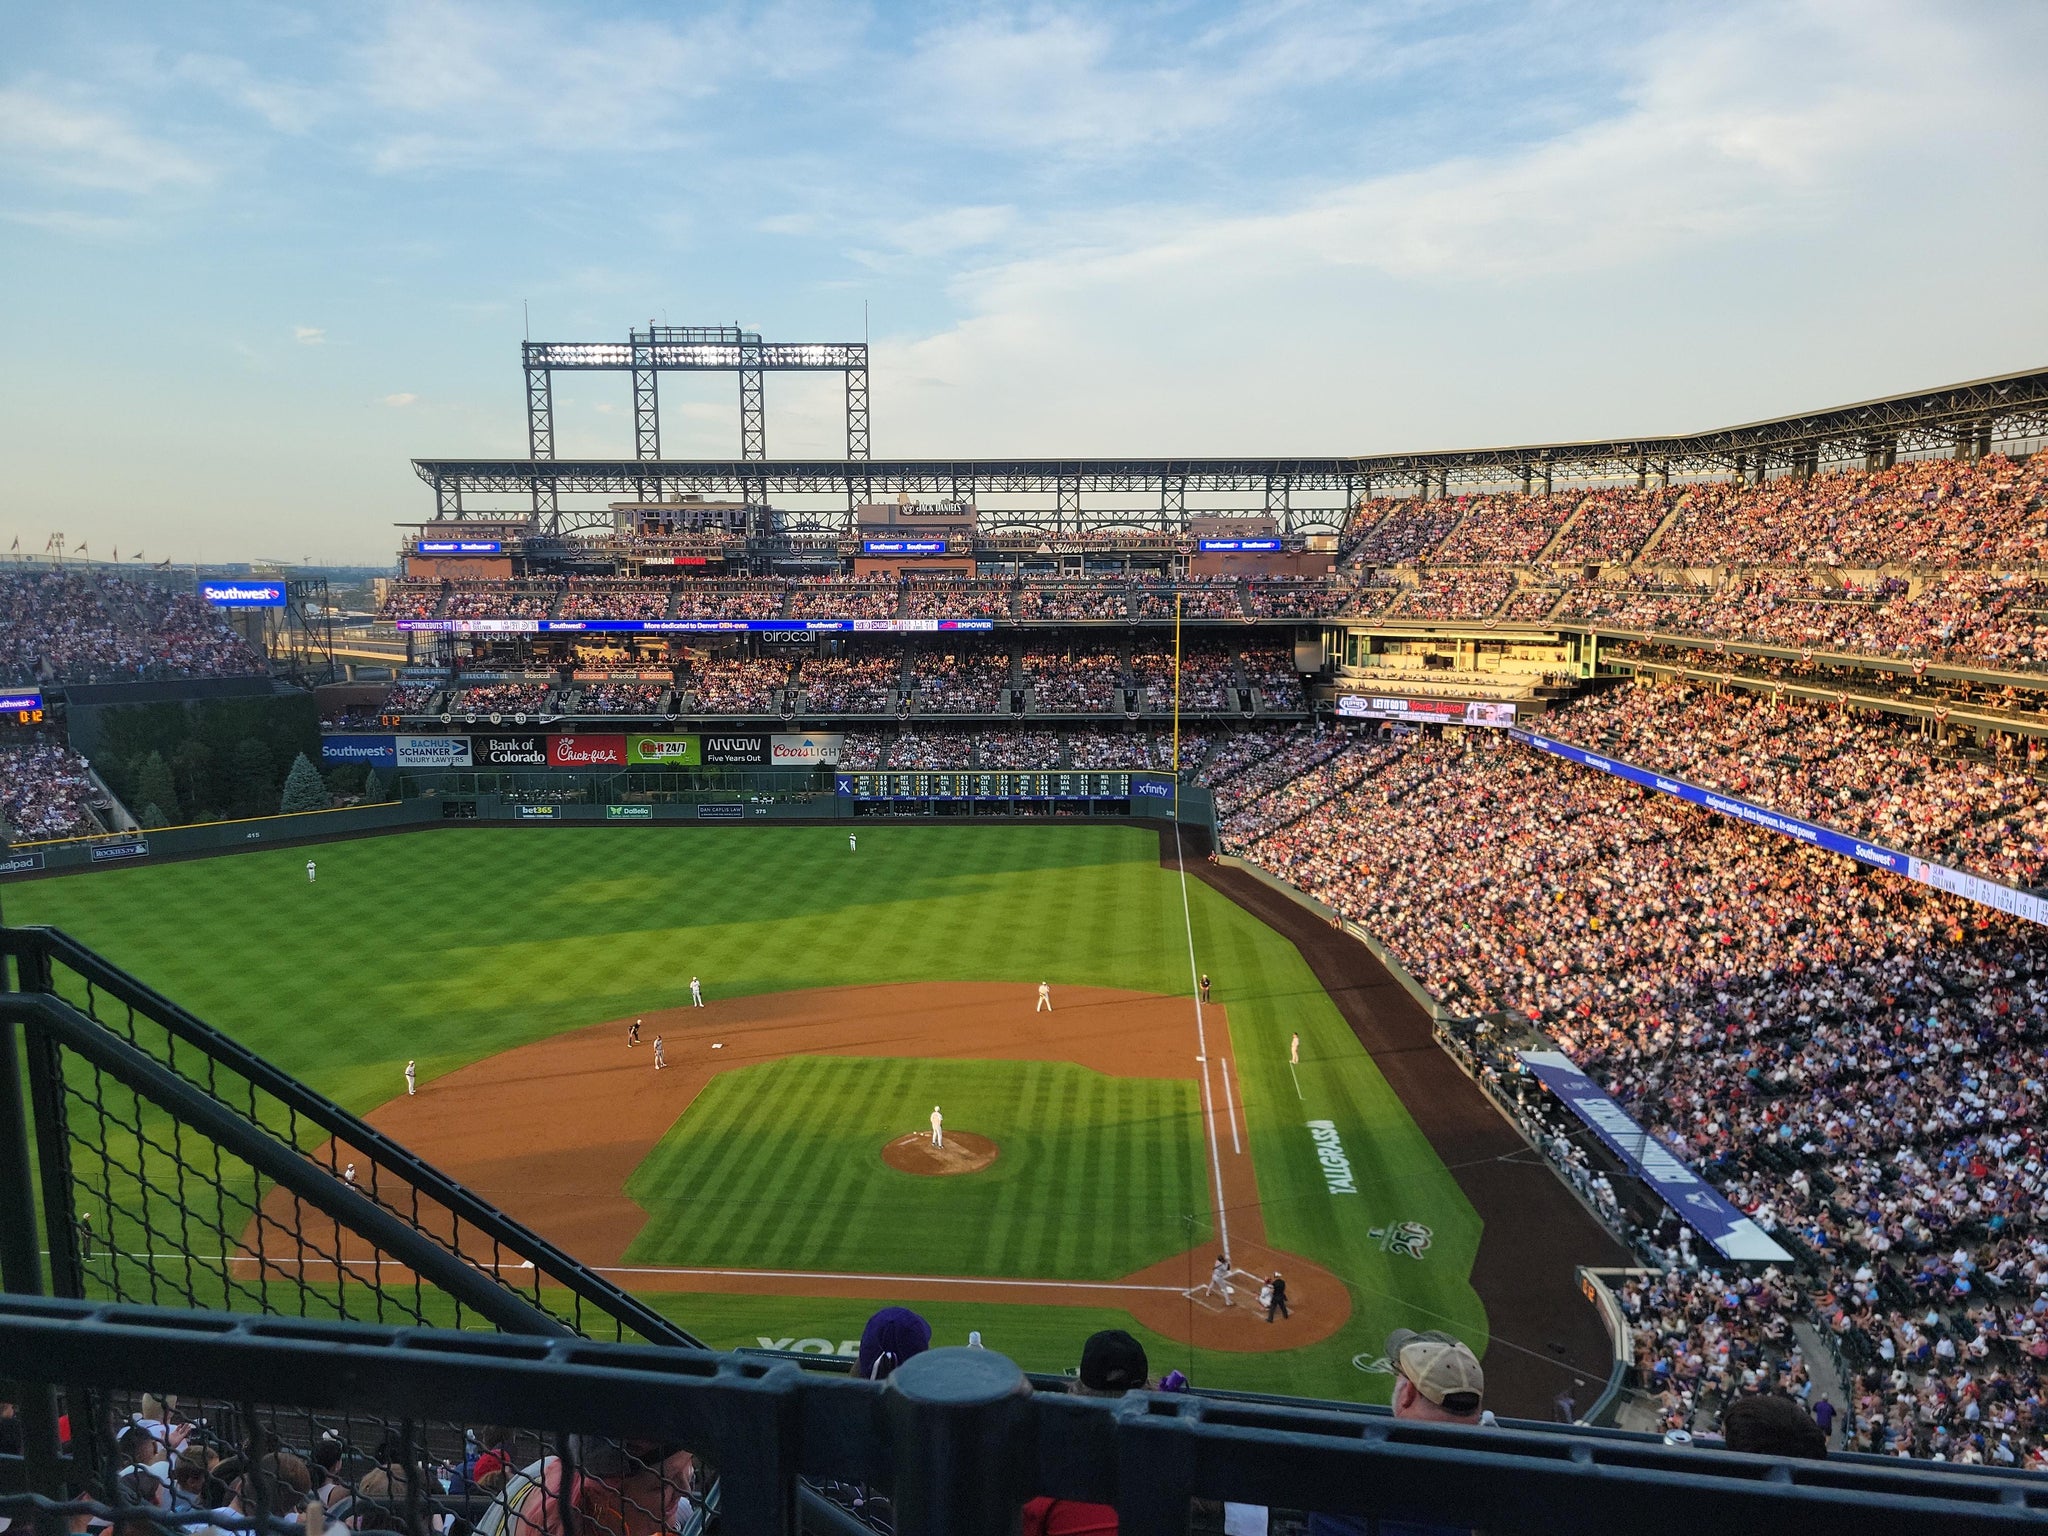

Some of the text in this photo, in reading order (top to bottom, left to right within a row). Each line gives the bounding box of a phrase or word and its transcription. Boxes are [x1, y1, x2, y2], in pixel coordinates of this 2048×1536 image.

[916, 502, 933, 513] JACK
[1052, 544, 1084, 553] Silver
[645, 558, 706, 566] SMASHBURGER
[205, 586, 270, 600] Southwest
[411, 739, 450, 748] BACHUS
[490, 738, 535, 751] Bank of
[642, 743, 686, 754] Fix-it 24/7
[707, 738, 761, 751] ARROW
[322, 746, 385, 756] Southwest
[399, 748, 451, 756] SCHANKER
[773, 743, 809, 758] Coors
[405, 756, 464, 764] INJURY LAWYERS
[489, 750, 547, 763] Colorado
[707, 754, 761, 762] Five Years Out
[1138, 782, 1168, 797] xfinity
[522, 806, 554, 814] bet365
[623, 807, 649, 815] DaBella
[1855, 844, 1891, 866] Southwest
